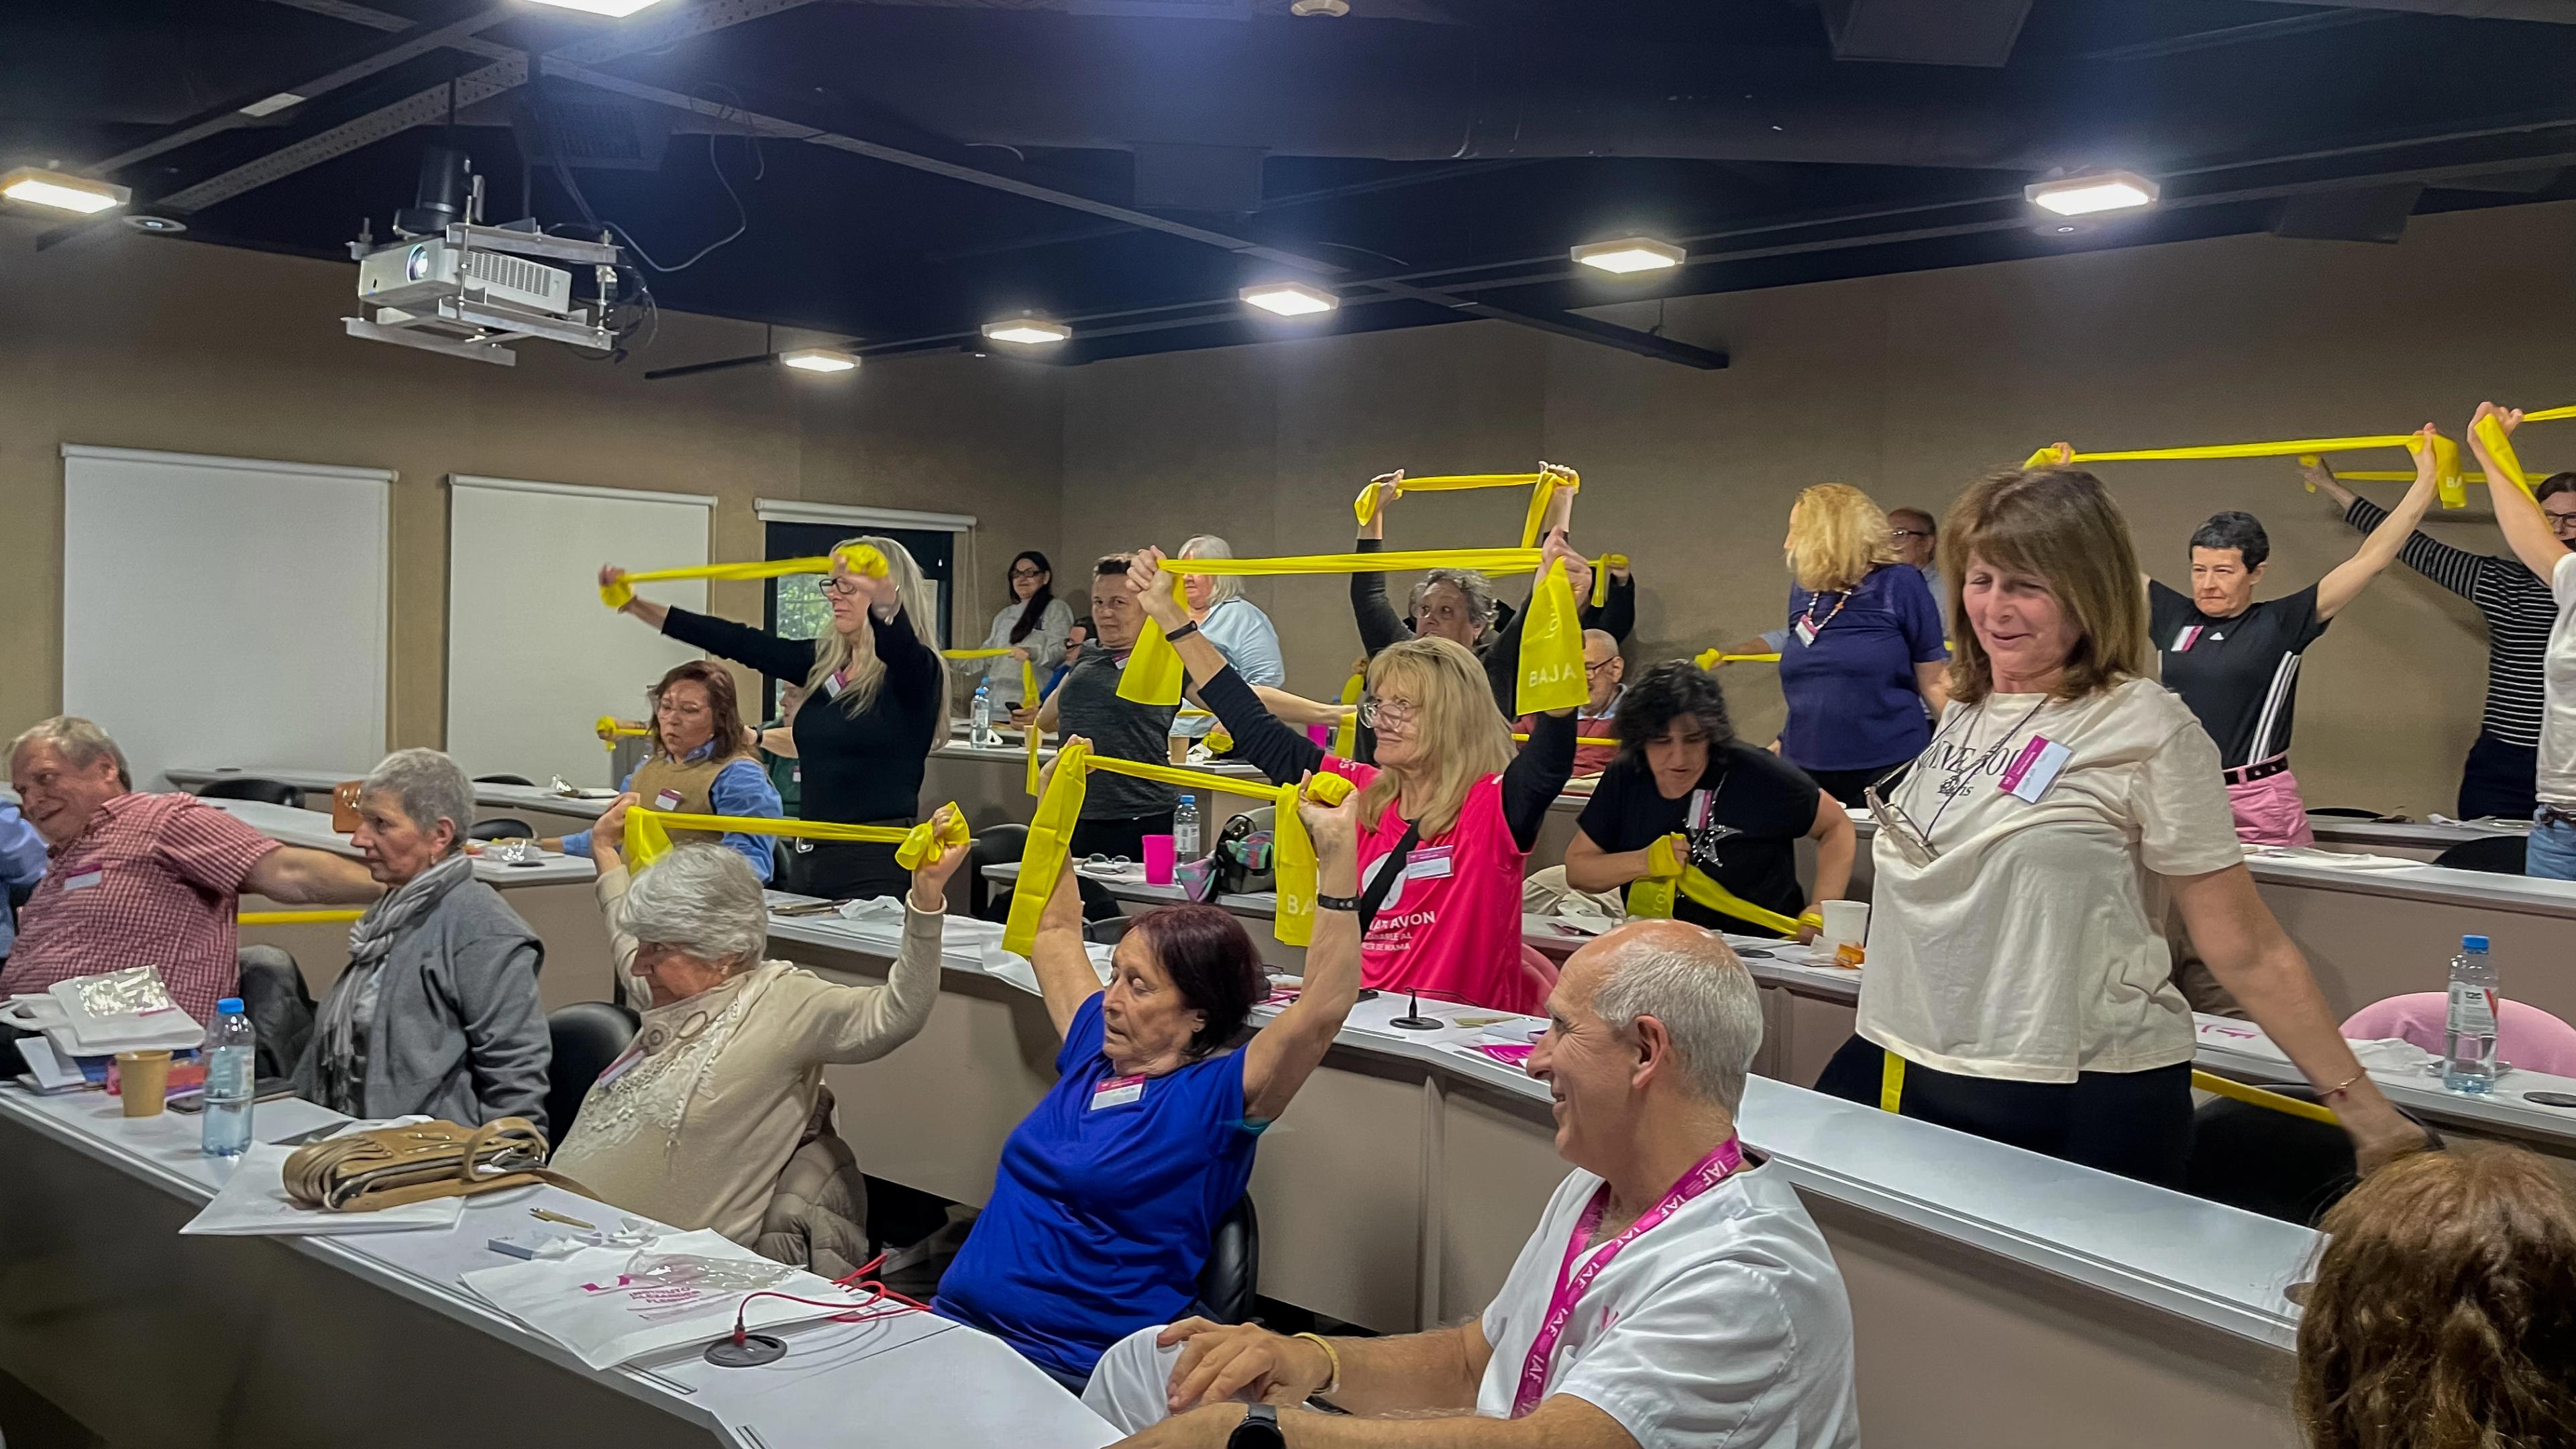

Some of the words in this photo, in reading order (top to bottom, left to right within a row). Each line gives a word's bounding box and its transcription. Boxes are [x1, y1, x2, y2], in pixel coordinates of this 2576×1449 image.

[1529, 663, 1577, 688] BAJA
[1390, 911, 1436, 929] AVON
[1702, 1160, 1728, 1187] IAF
[1660, 1194, 1686, 1218] IAF
[1617, 1227, 1641, 1248] IAF
[1578, 1262, 1600, 1289] IAF
[1550, 1308, 1569, 1338] IAF
[1529, 1354, 1545, 1383] IAF
